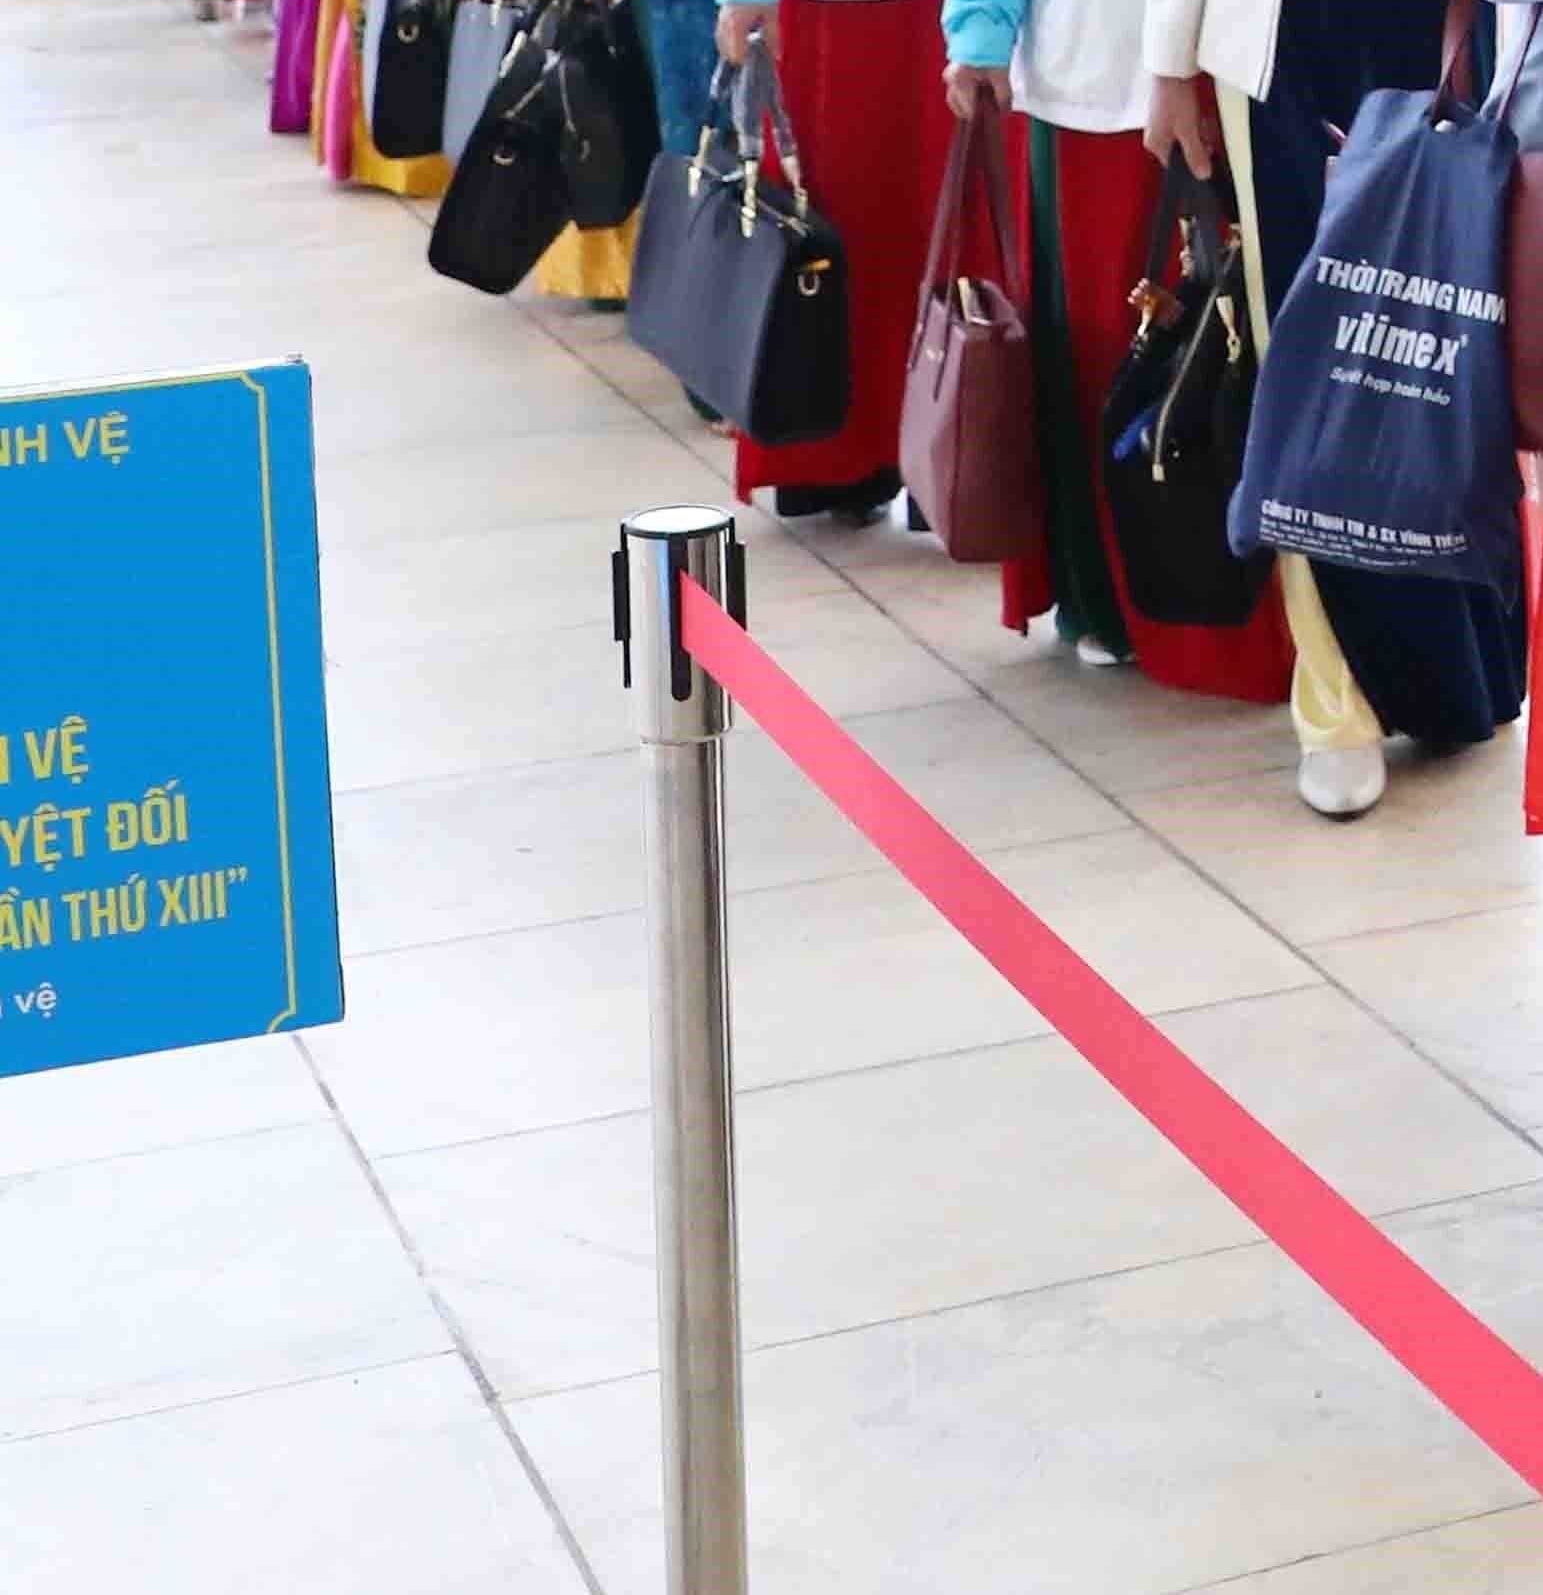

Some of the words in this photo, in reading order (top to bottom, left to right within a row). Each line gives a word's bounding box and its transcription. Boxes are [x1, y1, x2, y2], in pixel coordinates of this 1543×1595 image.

[63, 409, 131, 466] VỆ
[23, 714, 89, 784] VỆ
[105, 777, 189, 852] ĐỐI
[13, 981, 57, 1018] vệ
